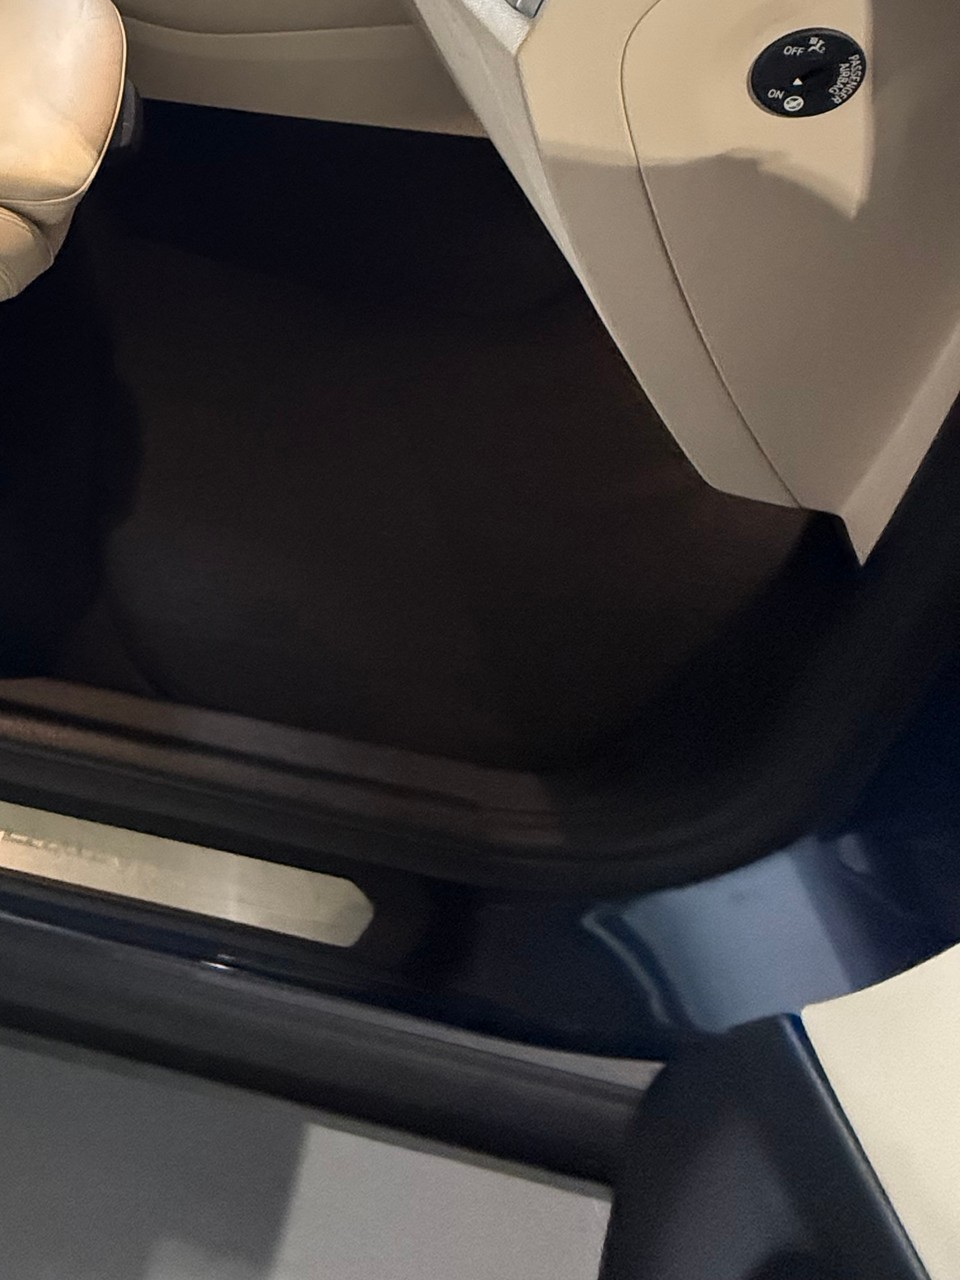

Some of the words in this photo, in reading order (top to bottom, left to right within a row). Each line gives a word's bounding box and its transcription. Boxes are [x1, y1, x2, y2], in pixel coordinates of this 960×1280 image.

[783, 45, 805, 56] OFF
[828, 62, 850, 93] AIRBAG
[831, 54, 862, 104] PASSENGER
[767, 88, 785, 100] ON
